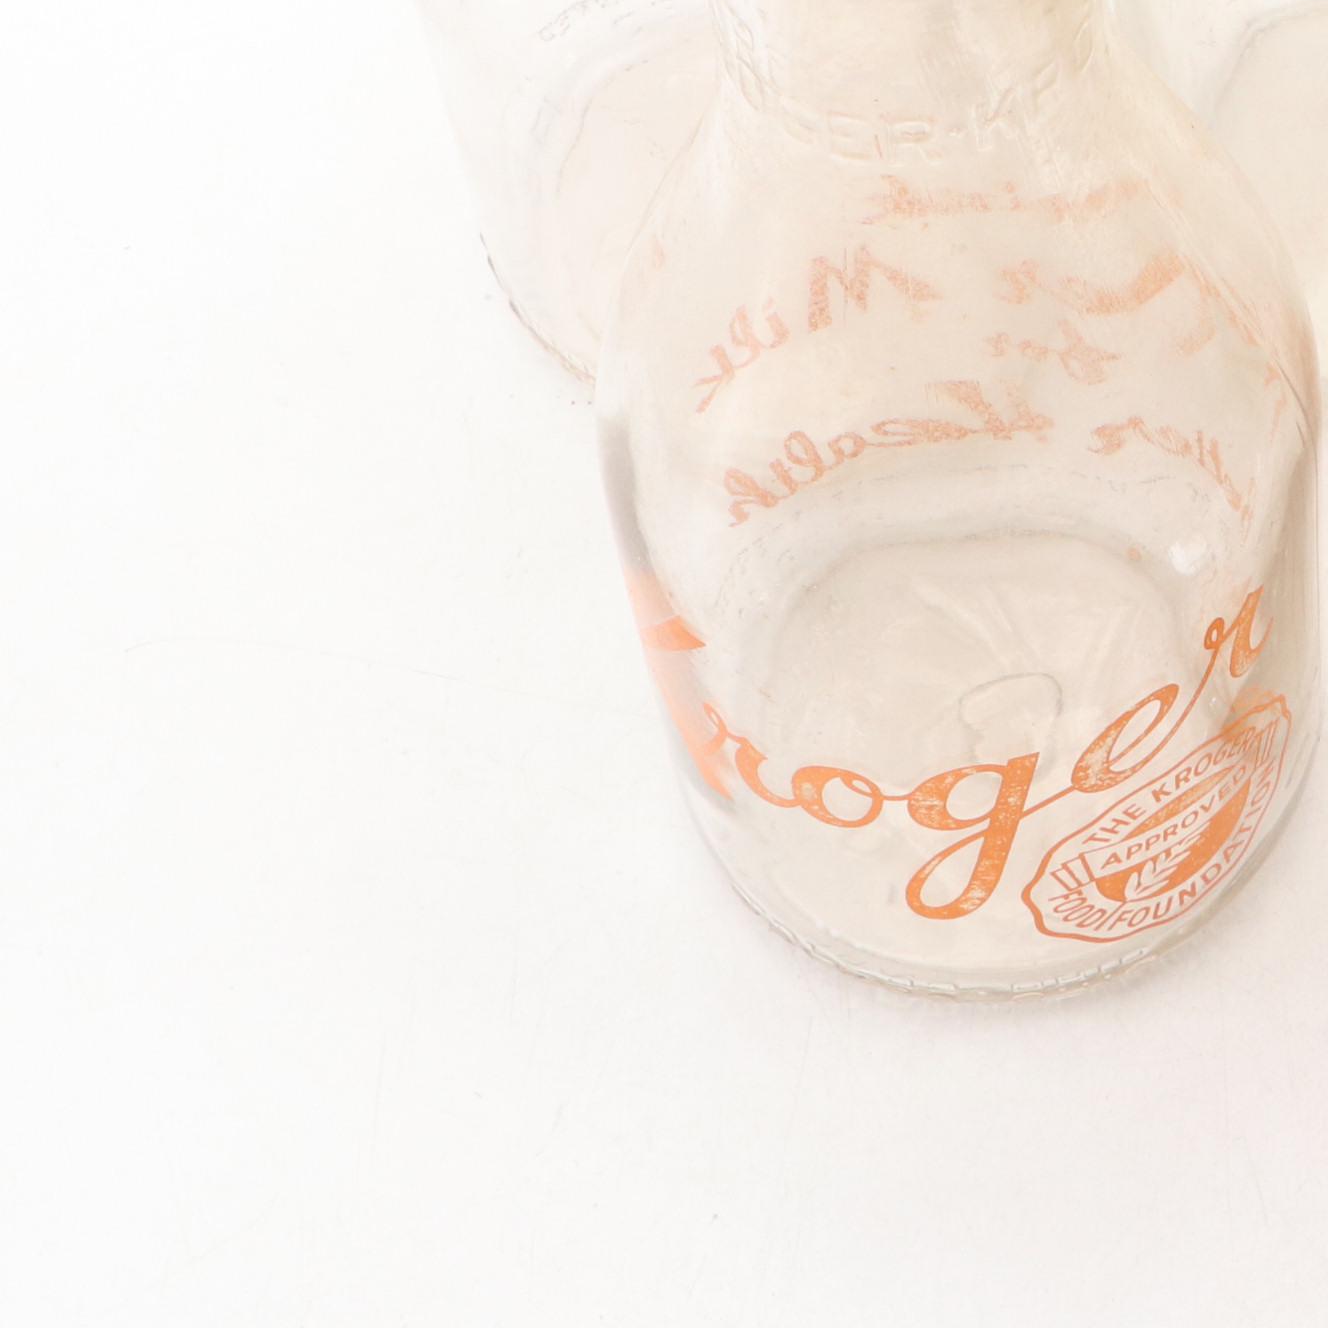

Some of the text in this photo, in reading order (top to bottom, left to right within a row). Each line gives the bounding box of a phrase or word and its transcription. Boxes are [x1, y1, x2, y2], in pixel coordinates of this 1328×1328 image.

[1047, 759, 1274, 932] FOOD FOUNDATION
[1081, 725, 1258, 846] THE KROGER
[1100, 763, 1248, 870] APPROVED
